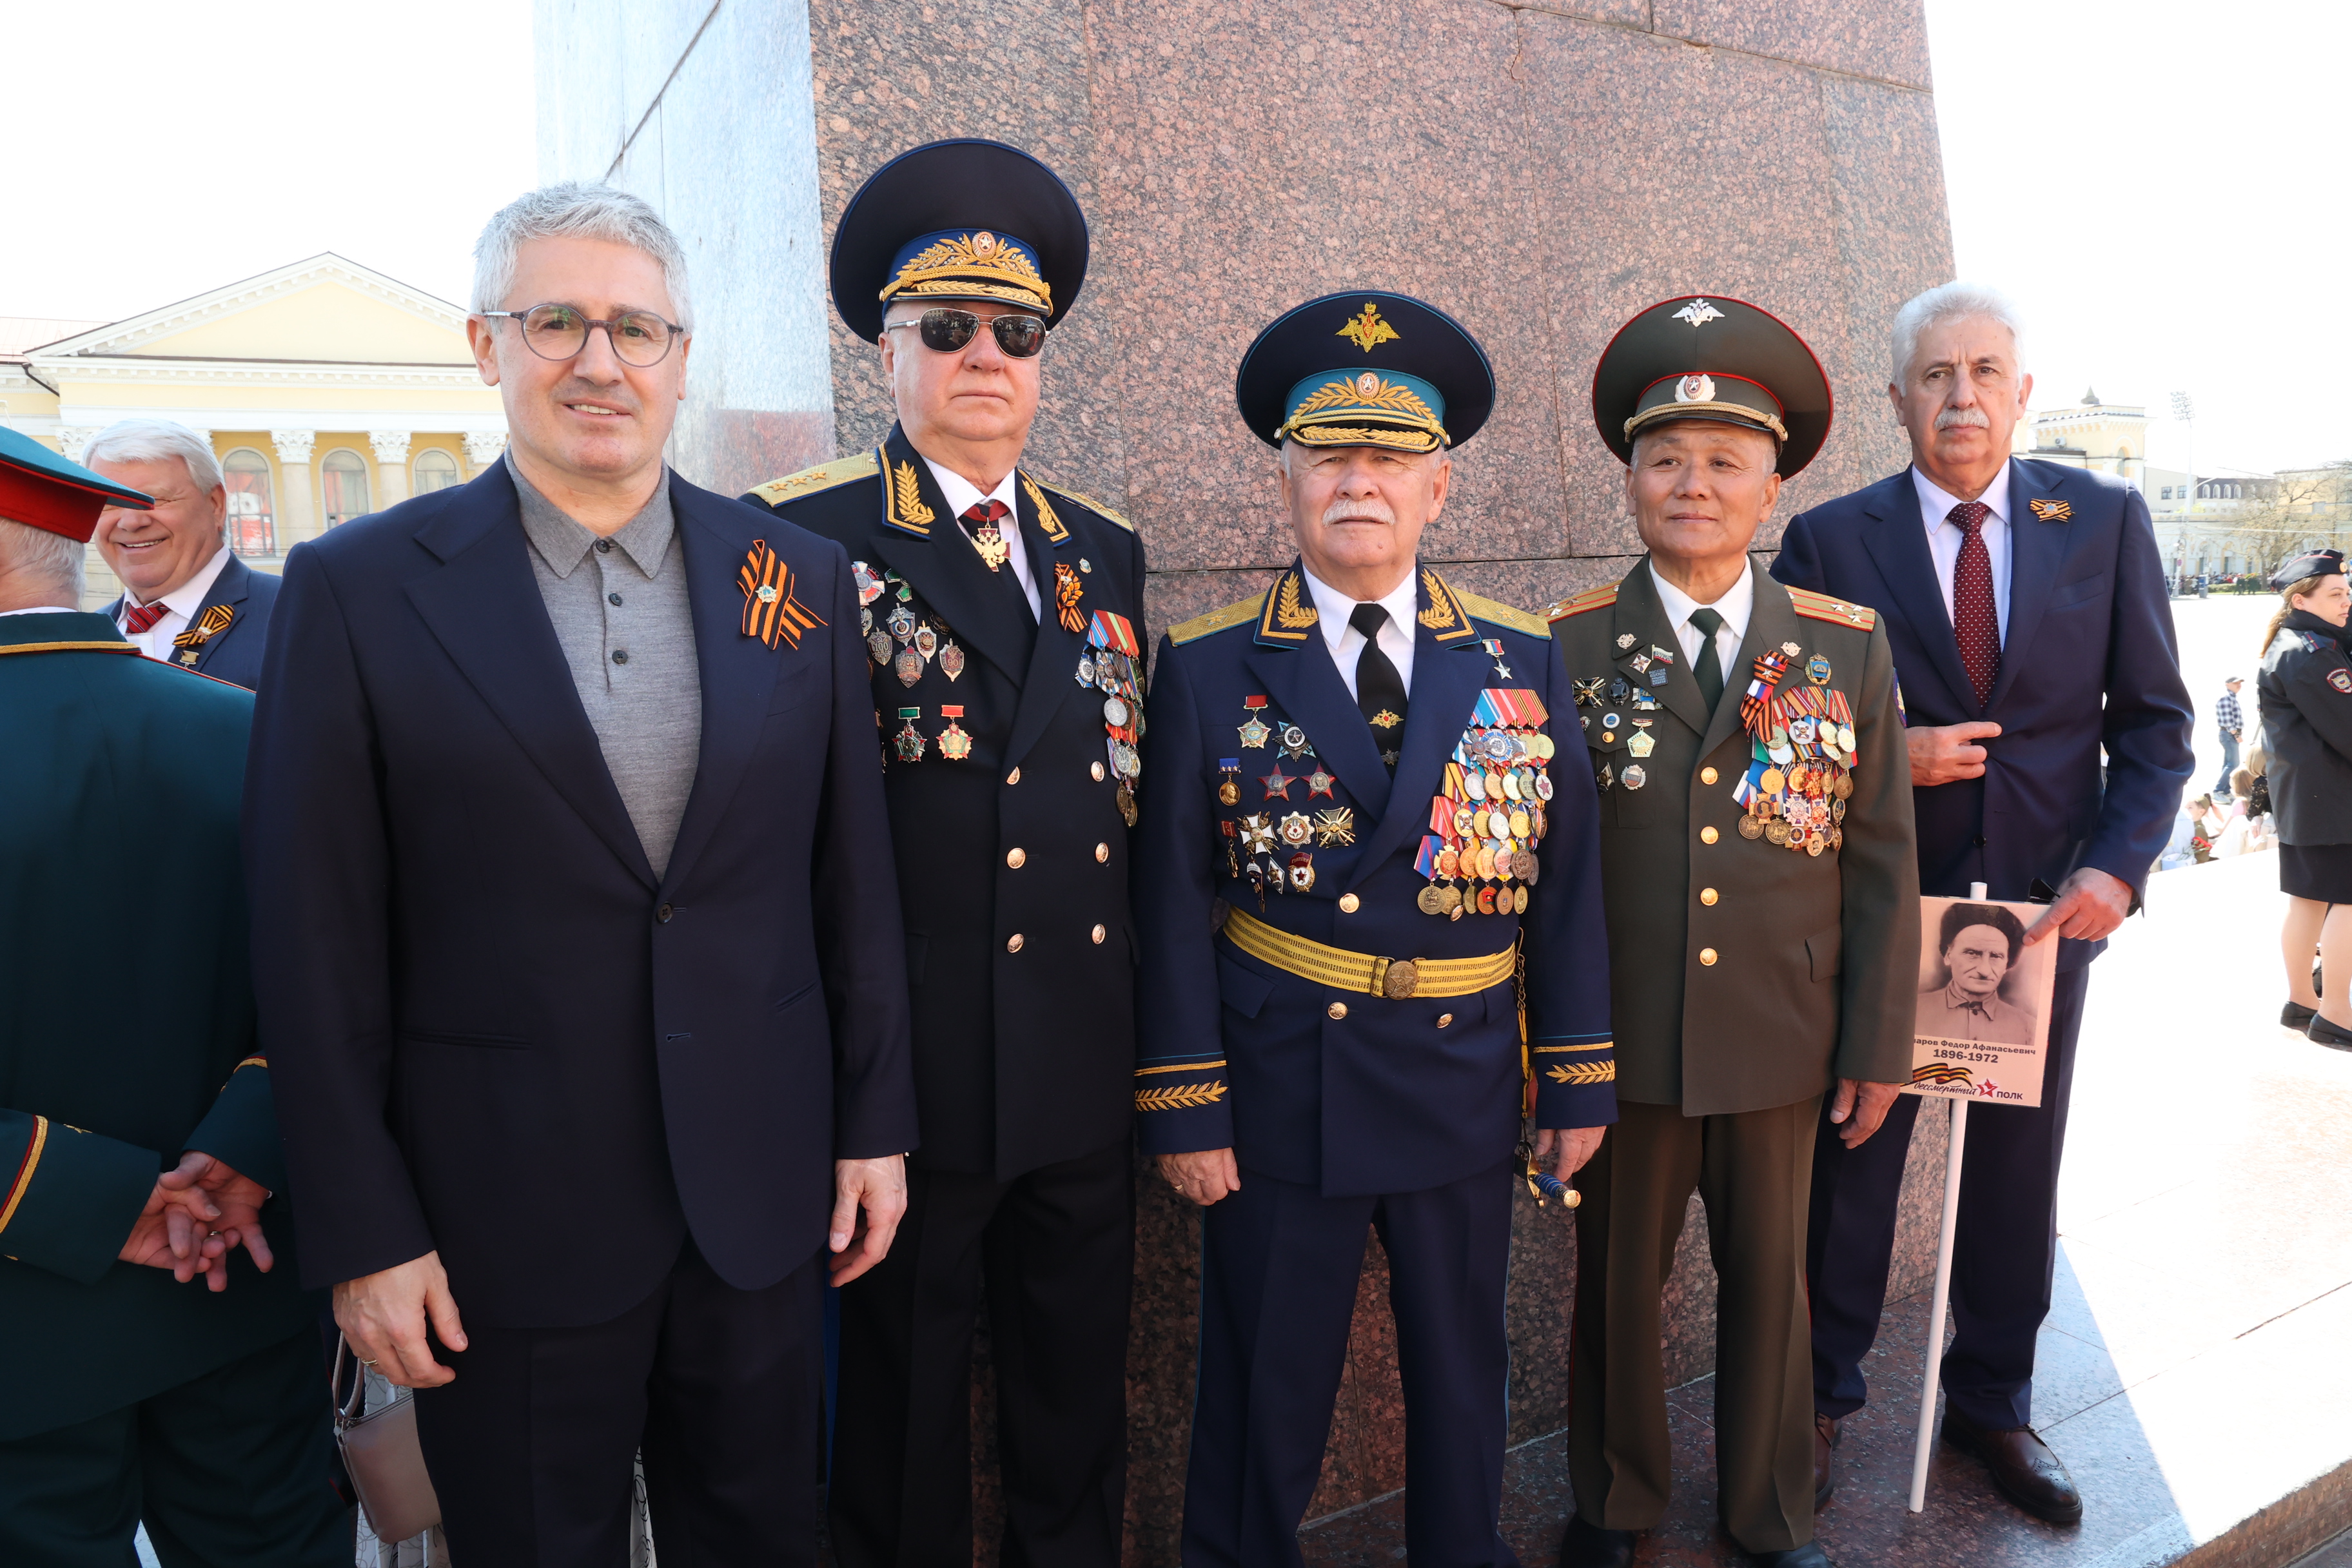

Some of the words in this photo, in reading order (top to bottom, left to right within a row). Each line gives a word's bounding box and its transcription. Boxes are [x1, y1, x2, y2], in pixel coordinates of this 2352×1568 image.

[874, 642, 889, 651] 100
[906, 655, 914, 666] 90
[947, 658, 959, 667] 90
[1941, 1039, 1970, 1050] Федор
[1972, 1043, 2036, 1055] Афанасьевич
[1933, 1048, 1999, 1063] 1896-1972
